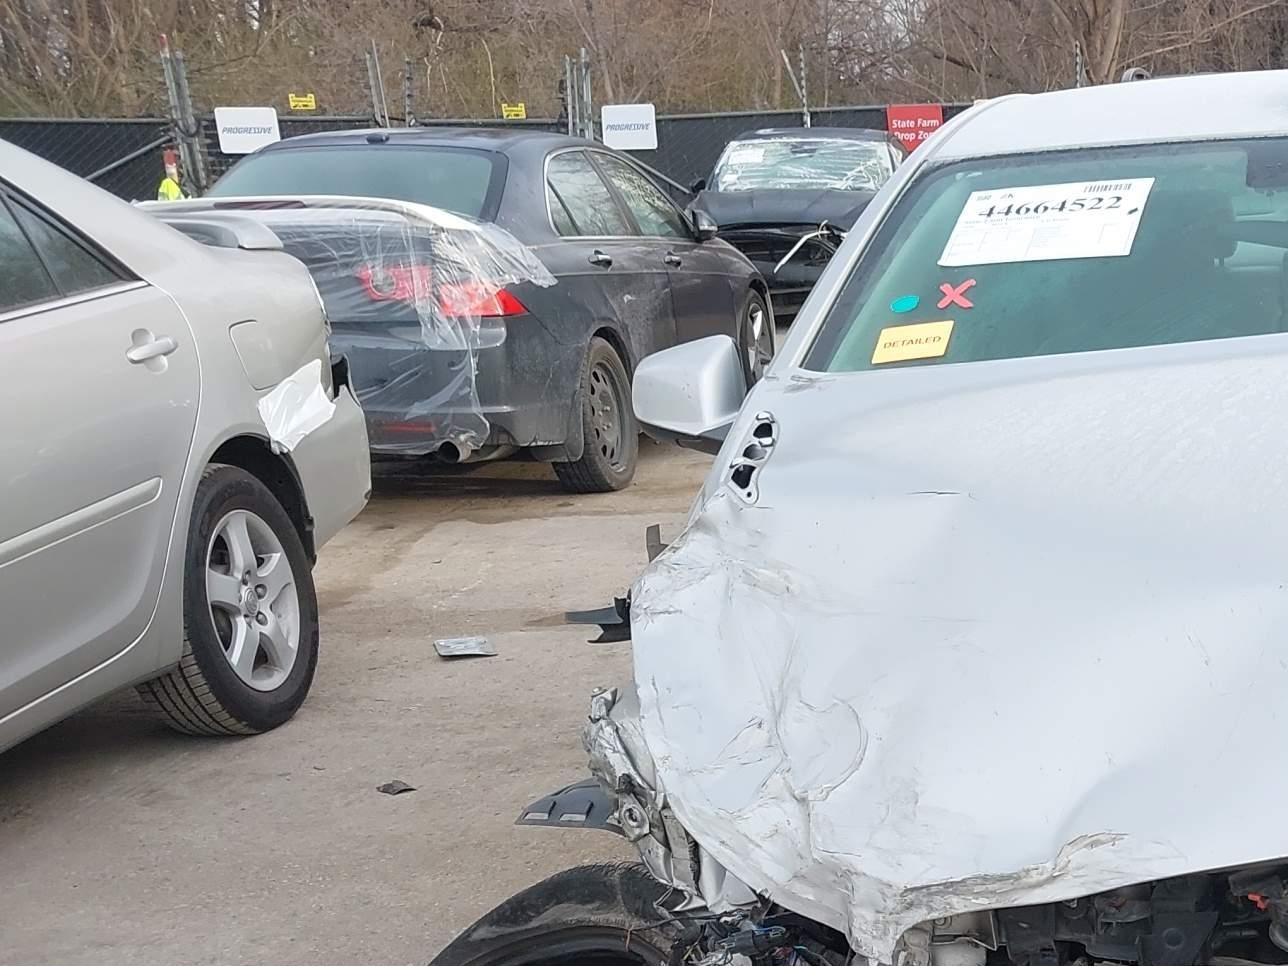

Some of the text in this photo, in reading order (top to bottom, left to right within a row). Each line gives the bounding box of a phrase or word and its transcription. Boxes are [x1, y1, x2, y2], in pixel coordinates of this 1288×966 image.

[605, 123, 651, 132] PROGRESSIVE
[891, 118, 940, 129] State Farm
[222, 126, 273, 135] PROGRESSIVE
[978, 195, 1123, 218] 44664522
[882, 335, 943, 350] DETAILED
